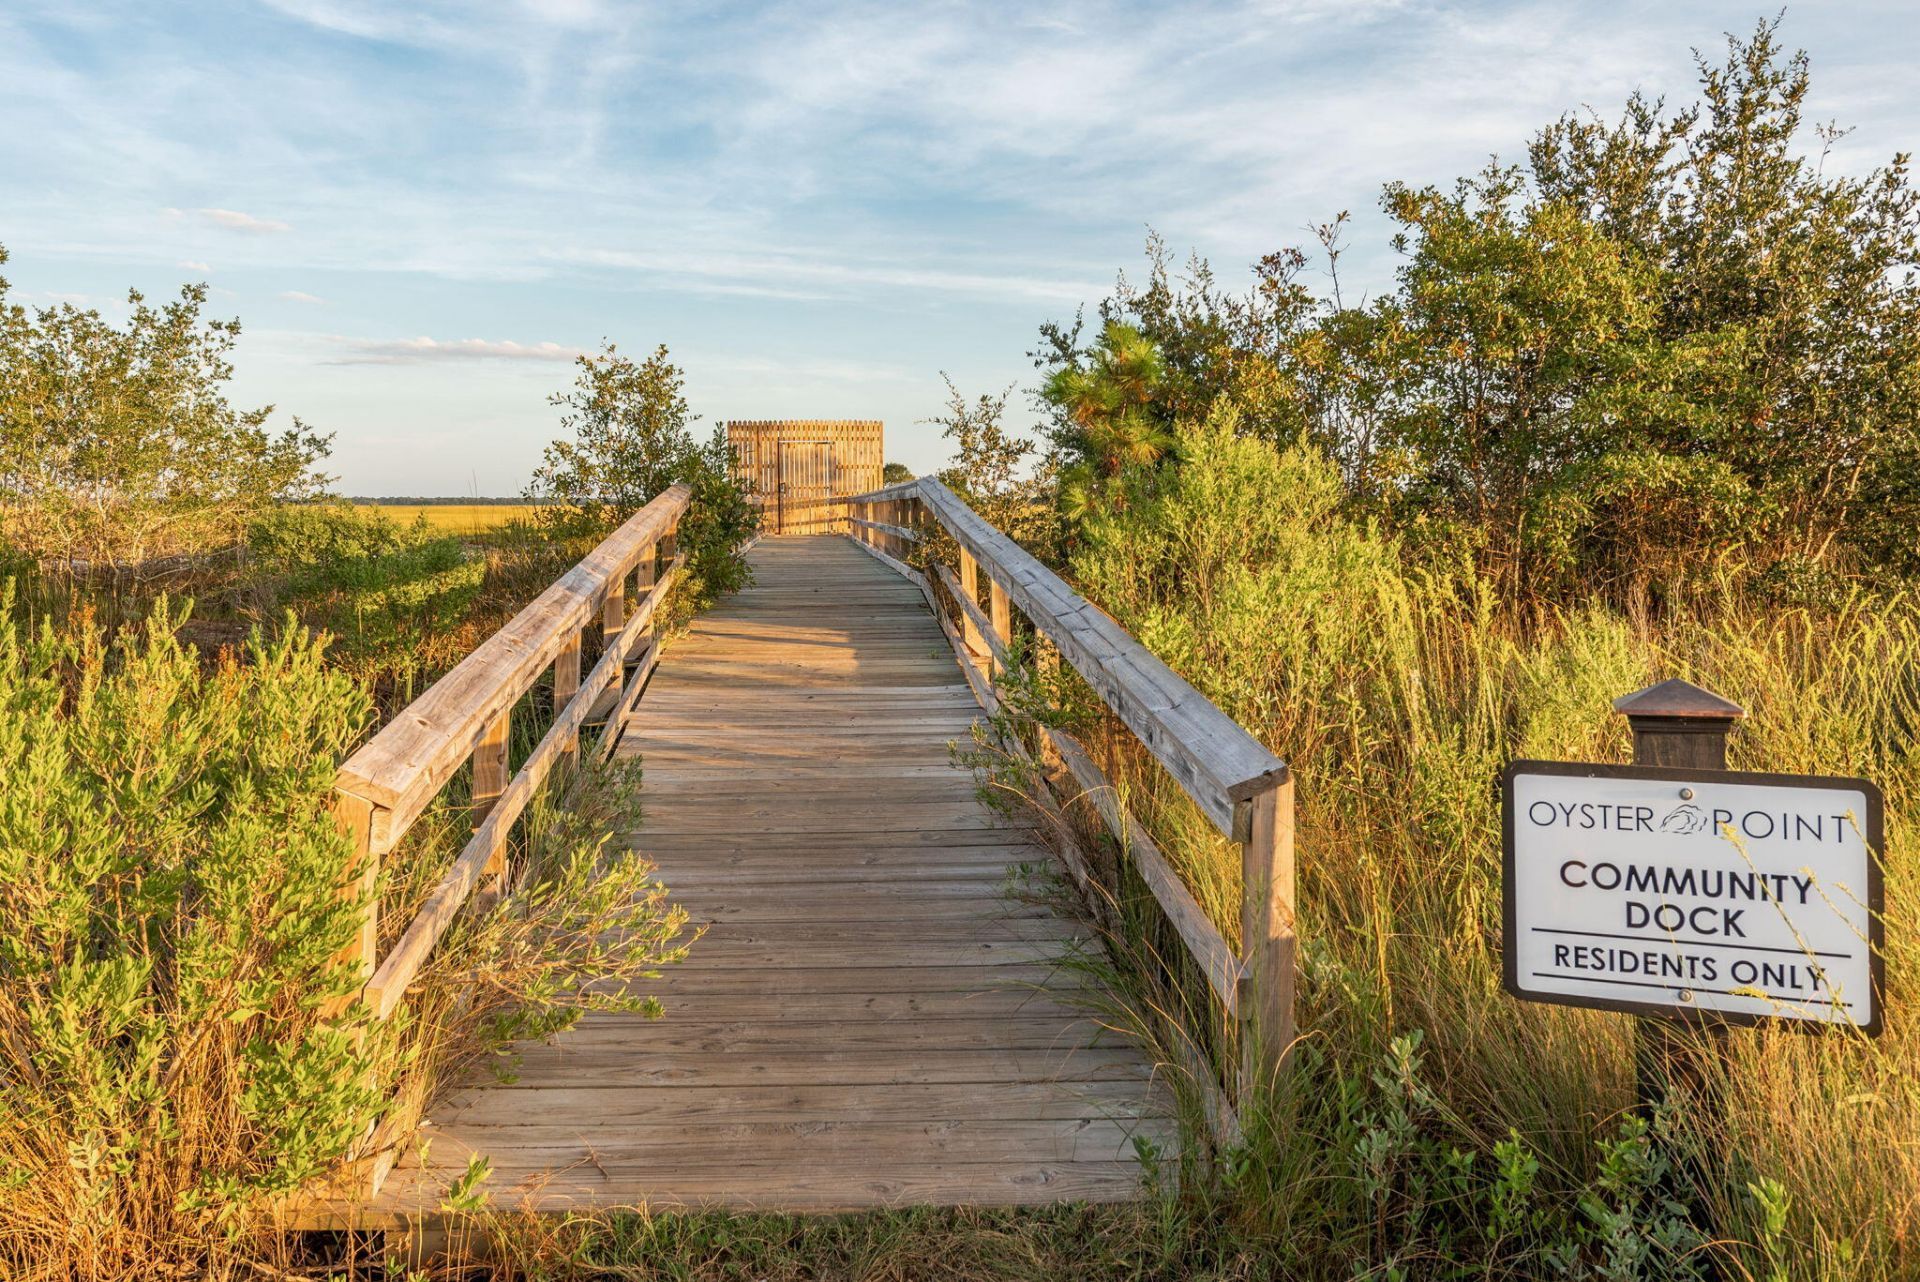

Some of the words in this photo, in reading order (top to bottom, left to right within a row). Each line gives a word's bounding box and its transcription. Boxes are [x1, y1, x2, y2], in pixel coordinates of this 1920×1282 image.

[1529, 801, 1654, 832] OYSTER
[1713, 809, 1850, 843] POINT
[1560, 860, 1814, 904] COMMUNITY
[1626, 901, 1746, 937] DOCK
[1554, 944, 1717, 981] RESIDENTS
[1731, 960, 1825, 991] ONLY
